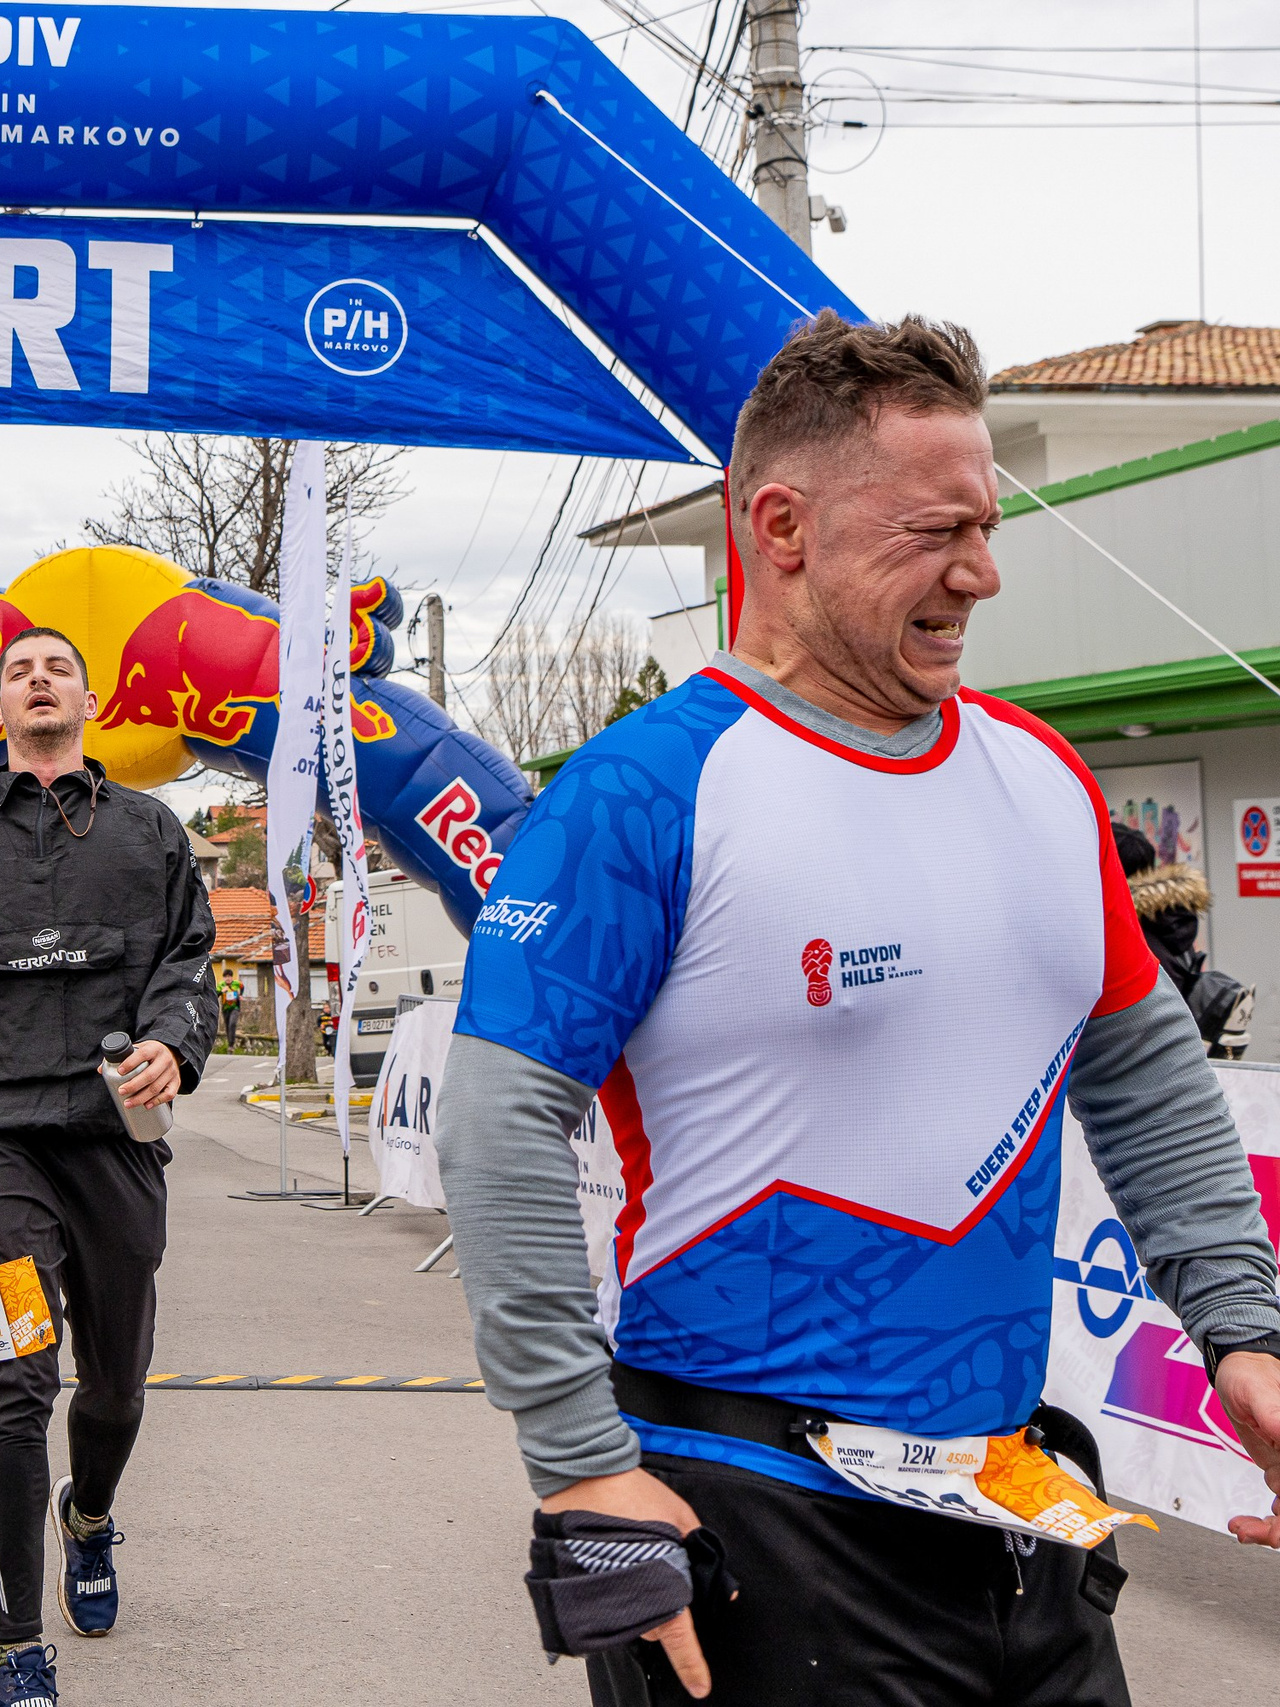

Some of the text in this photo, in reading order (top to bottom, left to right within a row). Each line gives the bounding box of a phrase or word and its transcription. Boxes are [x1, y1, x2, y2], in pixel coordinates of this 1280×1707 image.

[2, 93, 36, 114] IN
[1, 124, 181, 148] MARKOVO
[349, 298, 362, 306] IN
[324, 308, 389, 340] P/H
[324, 341, 388, 353] MARKOVO
[35, 931, 59, 945] NISSAN
[839, 943, 901, 968] PLOVDIV
[841, 966, 885, 988] HILLS
[888, 969, 923, 979] MARKOVO
[1011, 1087, 1041, 1139] STEP
[12, 1322, 33, 1342] STEP
[837, 1447, 874, 1459] PLOVDIV
[840, 1457, 865, 1467] HILLS
[902, 1443, 937, 1465] 12K
[77, 1577, 111, 1595] PUMA
